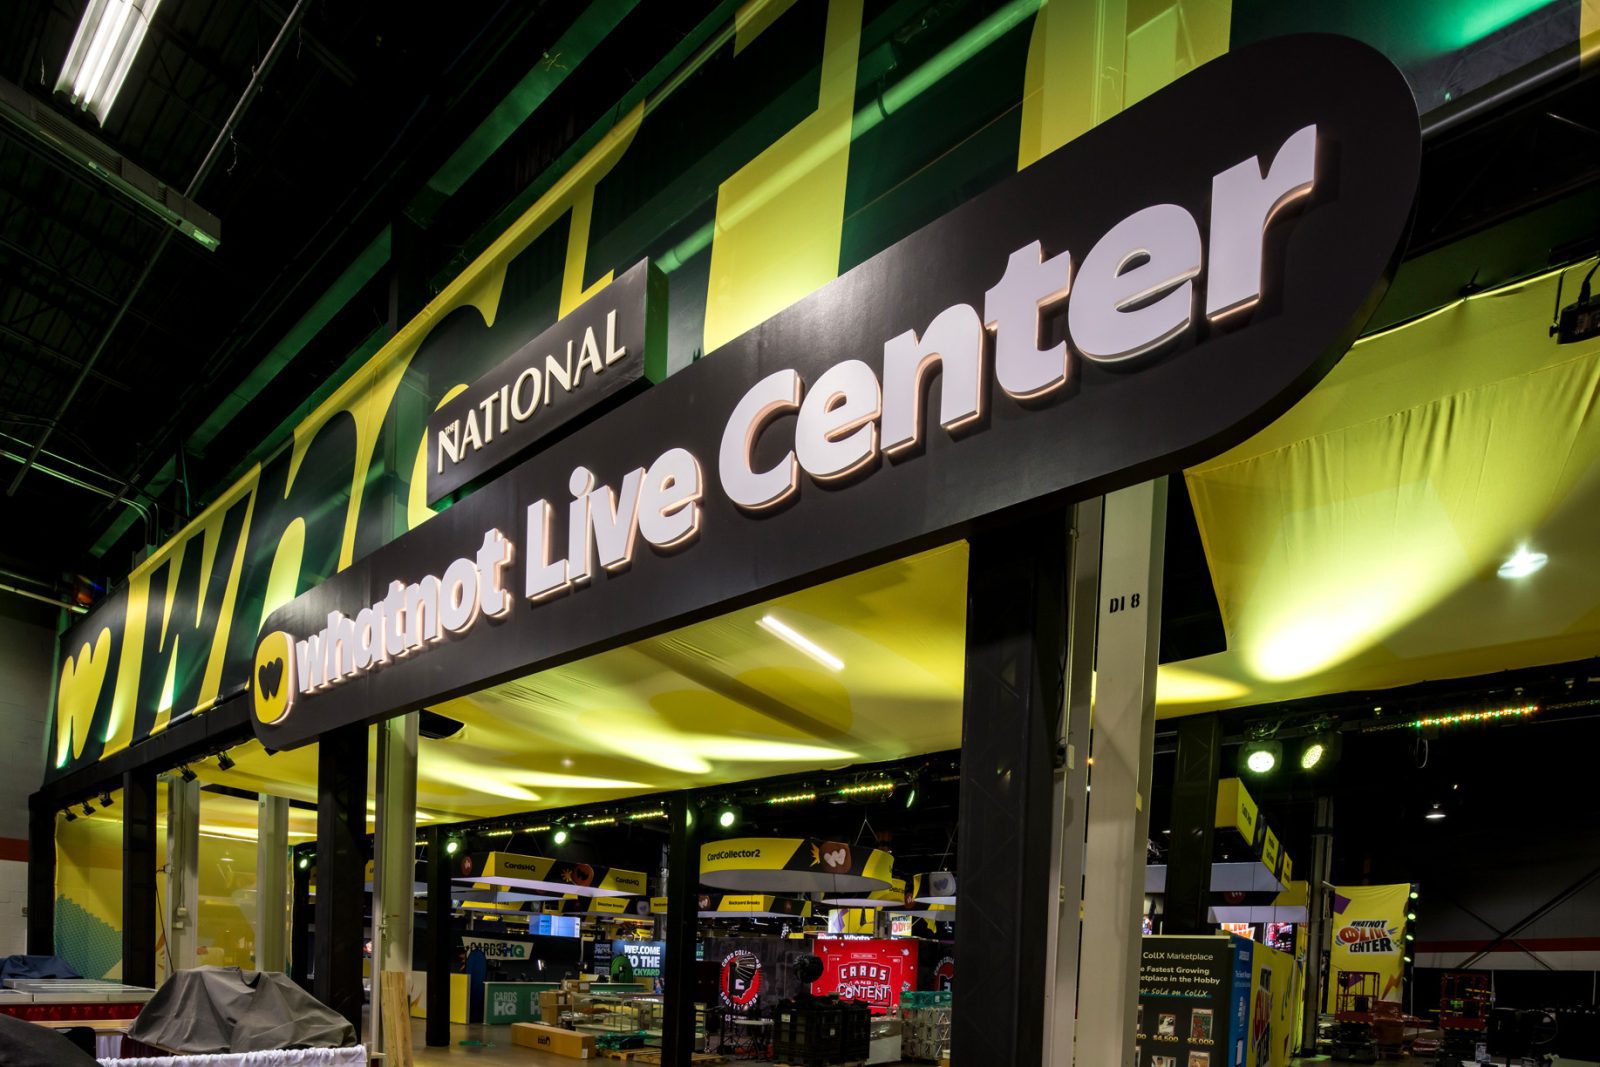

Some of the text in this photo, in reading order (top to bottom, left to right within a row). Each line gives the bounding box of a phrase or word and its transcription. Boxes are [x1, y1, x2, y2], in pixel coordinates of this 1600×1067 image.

[438, 309, 626, 474] NATIONAL
[295, 123, 1317, 694] whatnot Live Center
[444, 423, 457, 436] THE
[1131, 593, 1141, 608] 8
[707, 848, 761, 862] CardCollector2
[504, 861, 536, 873] CardsHQ
[615, 876, 640, 887] CardsHQ
[1350, 920, 1387, 928] WHATNOT
[1359, 928, 1387, 942] LIVE
[623, 945, 661, 956] WELCOME
[1349, 938, 1393, 953] CENTER
[627, 955, 661, 968] O THE
[1143, 951, 1214, 961] CollX Marketplace
[632, 968, 660, 977] CKYARD
[840, 965, 887, 981] CARDS
[1146, 966, 1174, 974] Fastest
[1176, 966, 1210, 976] Growing
[1140, 975, 1168, 984] etplace
[1194, 977, 1221, 986] Hobby
[494, 991, 518, 1002] CARDS
[837, 983, 891, 1001] CONTENT
[1151, 987, 1169, 996] Sold
[1184, 989, 1209, 998] CollX
[494, 1002, 517, 1017] HQ
